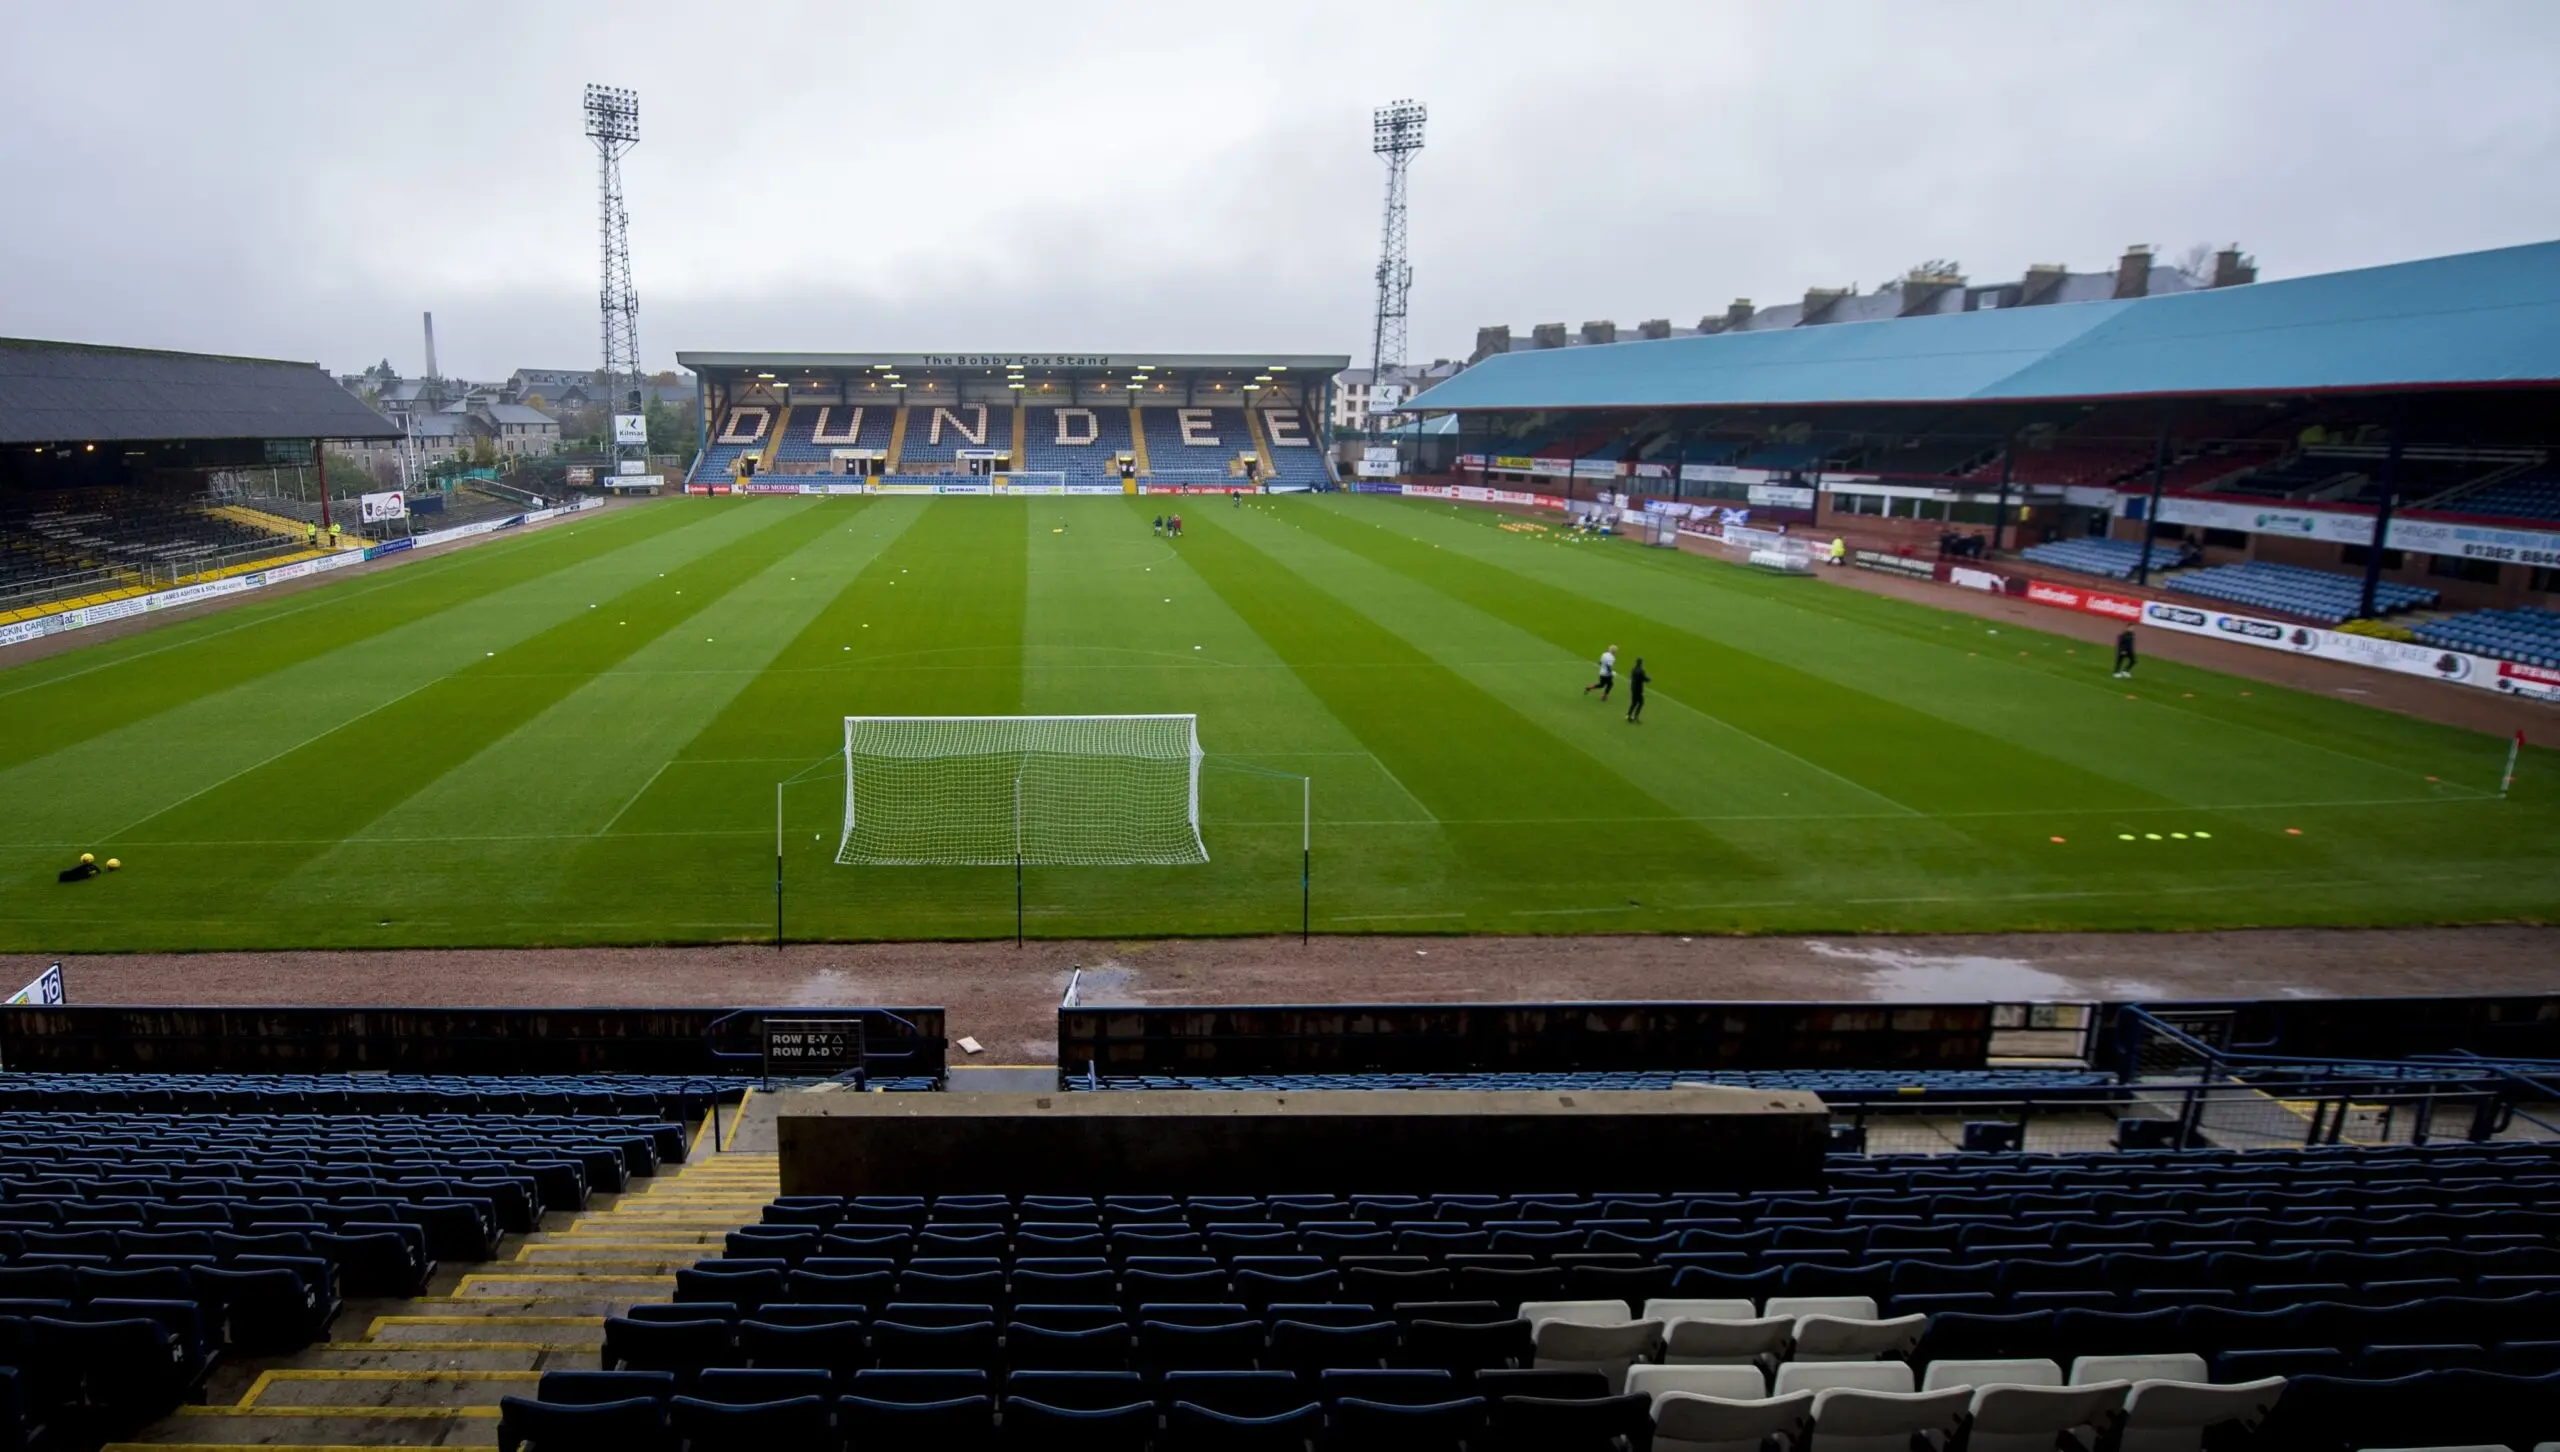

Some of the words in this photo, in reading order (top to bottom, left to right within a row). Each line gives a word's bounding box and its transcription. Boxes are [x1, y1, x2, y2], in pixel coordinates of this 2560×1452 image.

[923, 356, 952, 365] The
[958, 356, 1012, 366] Bobby
[1019, 356, 1051, 365] Cox
[1056, 356, 1109, 365] Stand
[716, 403, 1310, 446] DUNDEE
[162, 591, 180, 601] JAMES
[180, 588, 200, 597] ASHTON
[43, 973, 59, 1004] 16
[772, 1034, 802, 1044] ROW
[807, 1034, 828, 1044] E-Y
[772, 1047, 802, 1056] ROW
[807, 1047, 830, 1056] A-D
